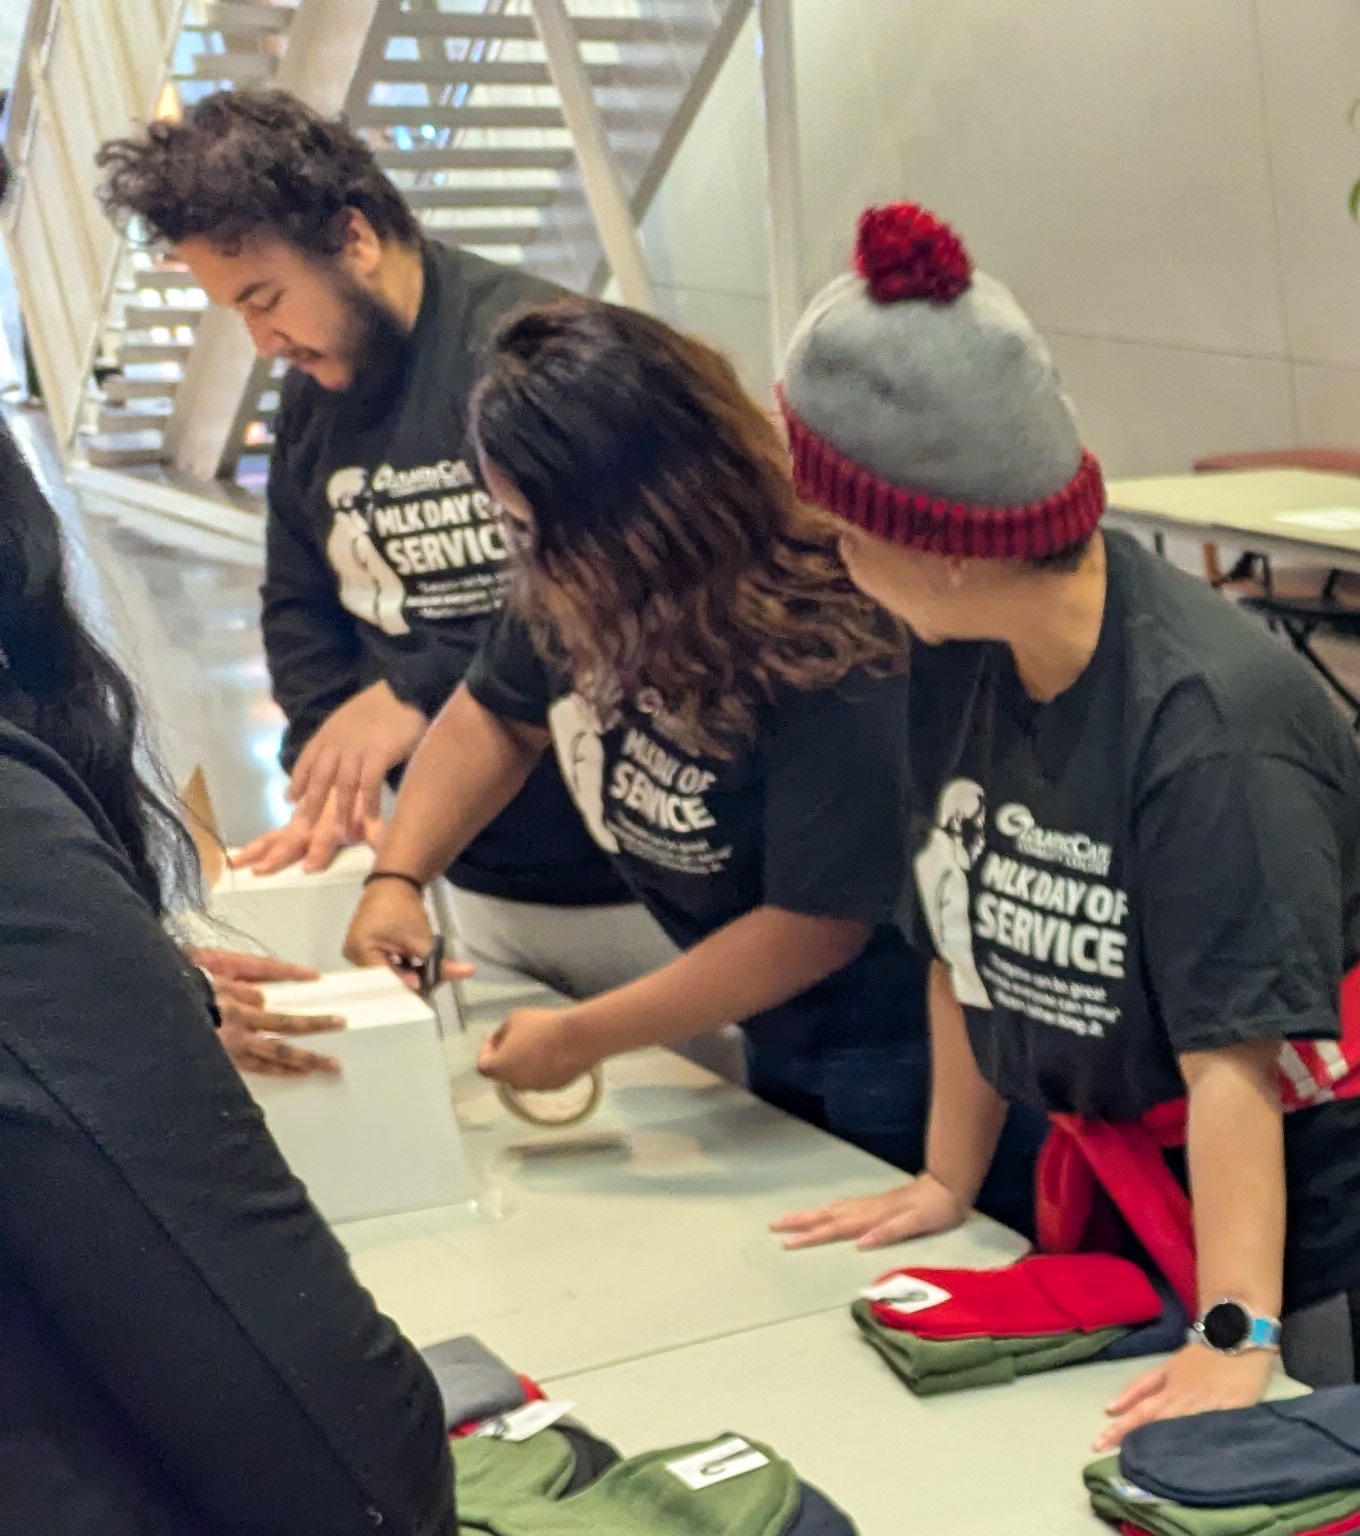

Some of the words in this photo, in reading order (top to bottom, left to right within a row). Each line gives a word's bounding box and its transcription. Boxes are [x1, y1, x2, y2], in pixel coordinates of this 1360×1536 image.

[374, 501, 425, 538] MLK
[422, 493, 471, 529] DAY
[386, 523, 508, 575] SERVIC
[980, 850, 1038, 901] MLK
[1031, 870, 1088, 917] DAY
[1083, 883, 1129, 926] OF
[974, 890, 1129, 980] SERVICE
